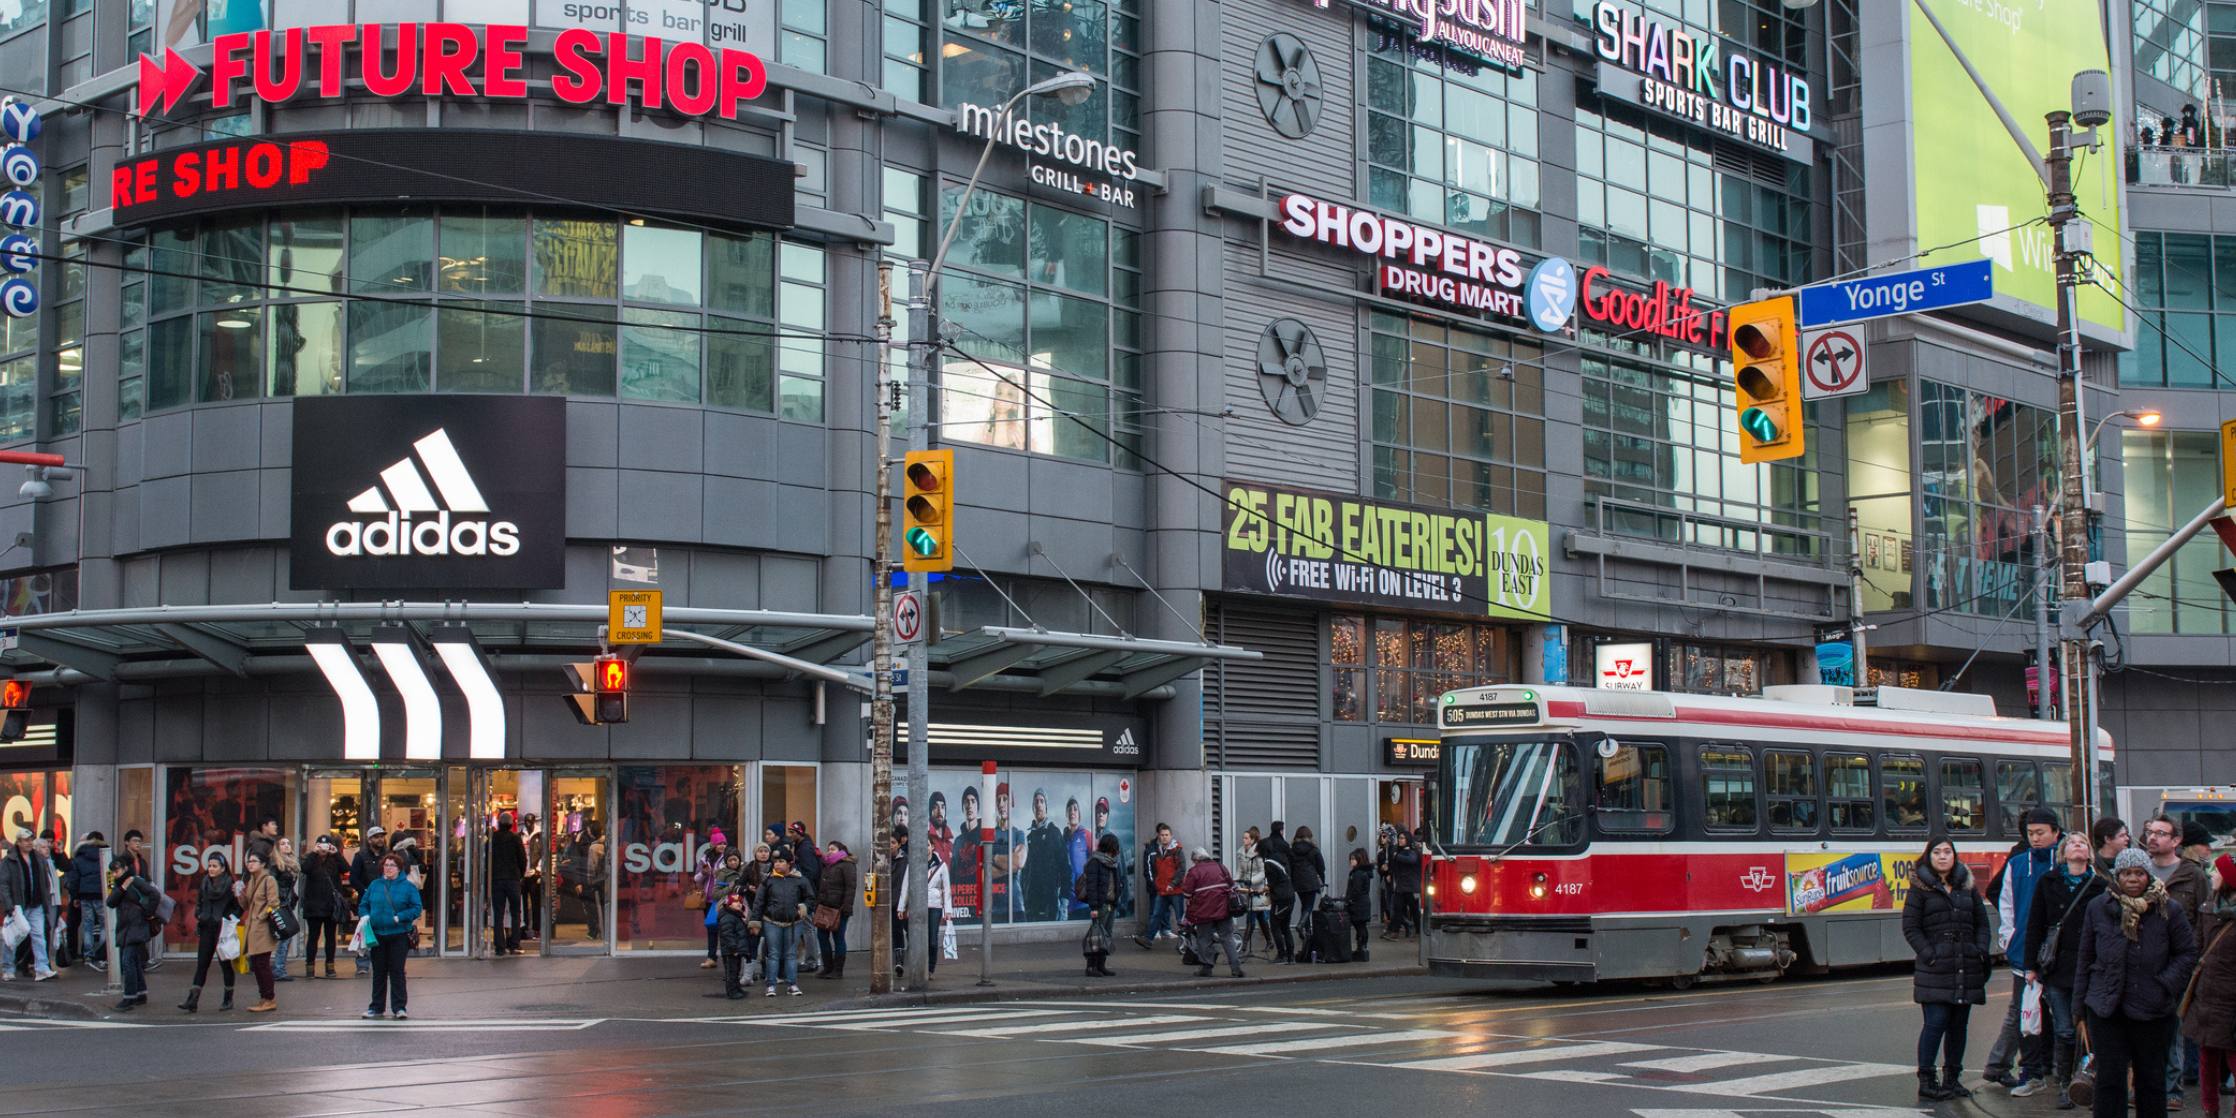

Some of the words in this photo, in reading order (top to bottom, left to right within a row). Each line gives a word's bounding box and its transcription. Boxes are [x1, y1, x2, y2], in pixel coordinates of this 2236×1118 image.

[563, 3, 649, 23] sports
[662, 9, 701, 32] bar
[711, 23, 746, 42] grill
[211, 23, 528, 111] FUTURE
[553, 28, 768, 120] SHOP
[1597, 2, 1717, 99] SHARK
[1730, 54, 1811, 131] CLUB
[1644, 79, 1704, 121] SPORTS
[1711, 102, 1741, 134] BAR
[1748, 116, 1788, 151] GRILL
[961, 101, 1137, 180] milestones
[112, 160, 157, 208] RE
[172, 140, 330, 198] SHOP
[1032, 165, 1082, 194] GRILL
[1101, 184, 1135, 208] BAR
[1281, 195, 1521, 288] SHOPPERS
[1387, 265, 1455, 303] DRUG
[1456, 286, 1522, 317] MART
[1582, 266, 1701, 343] GoodLife
[1845, 280, 1925, 311] Yonge
[1931, 271, 1946, 286] St
[325, 510, 521, 556] adidas
[1227, 487, 1269, 553] 25
[1276, 493, 1333, 560] FAB
[1342, 501, 1483, 577] EATERIES!
[1289, 559, 1329, 589] FREE
[1379, 568, 1401, 597] ON
[1405, 571, 1449, 601] LEVEL
[1451, 576, 1462, 603] 3
[1491, 550, 1544, 577] DUNDAS
[1491, 526, 1540, 610] 10
[1501, 573, 1535, 595] EAST
[619, 593, 652, 602] PRIORITY
[616, 631, 653, 640] CROSSING
[1447, 709, 1464, 722] 505
[1479, 692, 1498, 701] 4187
[1112, 743, 1139, 754] adidas
[173, 832, 251, 875] sal
[1555, 883, 1583, 895] 4187
[1825, 860, 1878, 894] fruitsource
